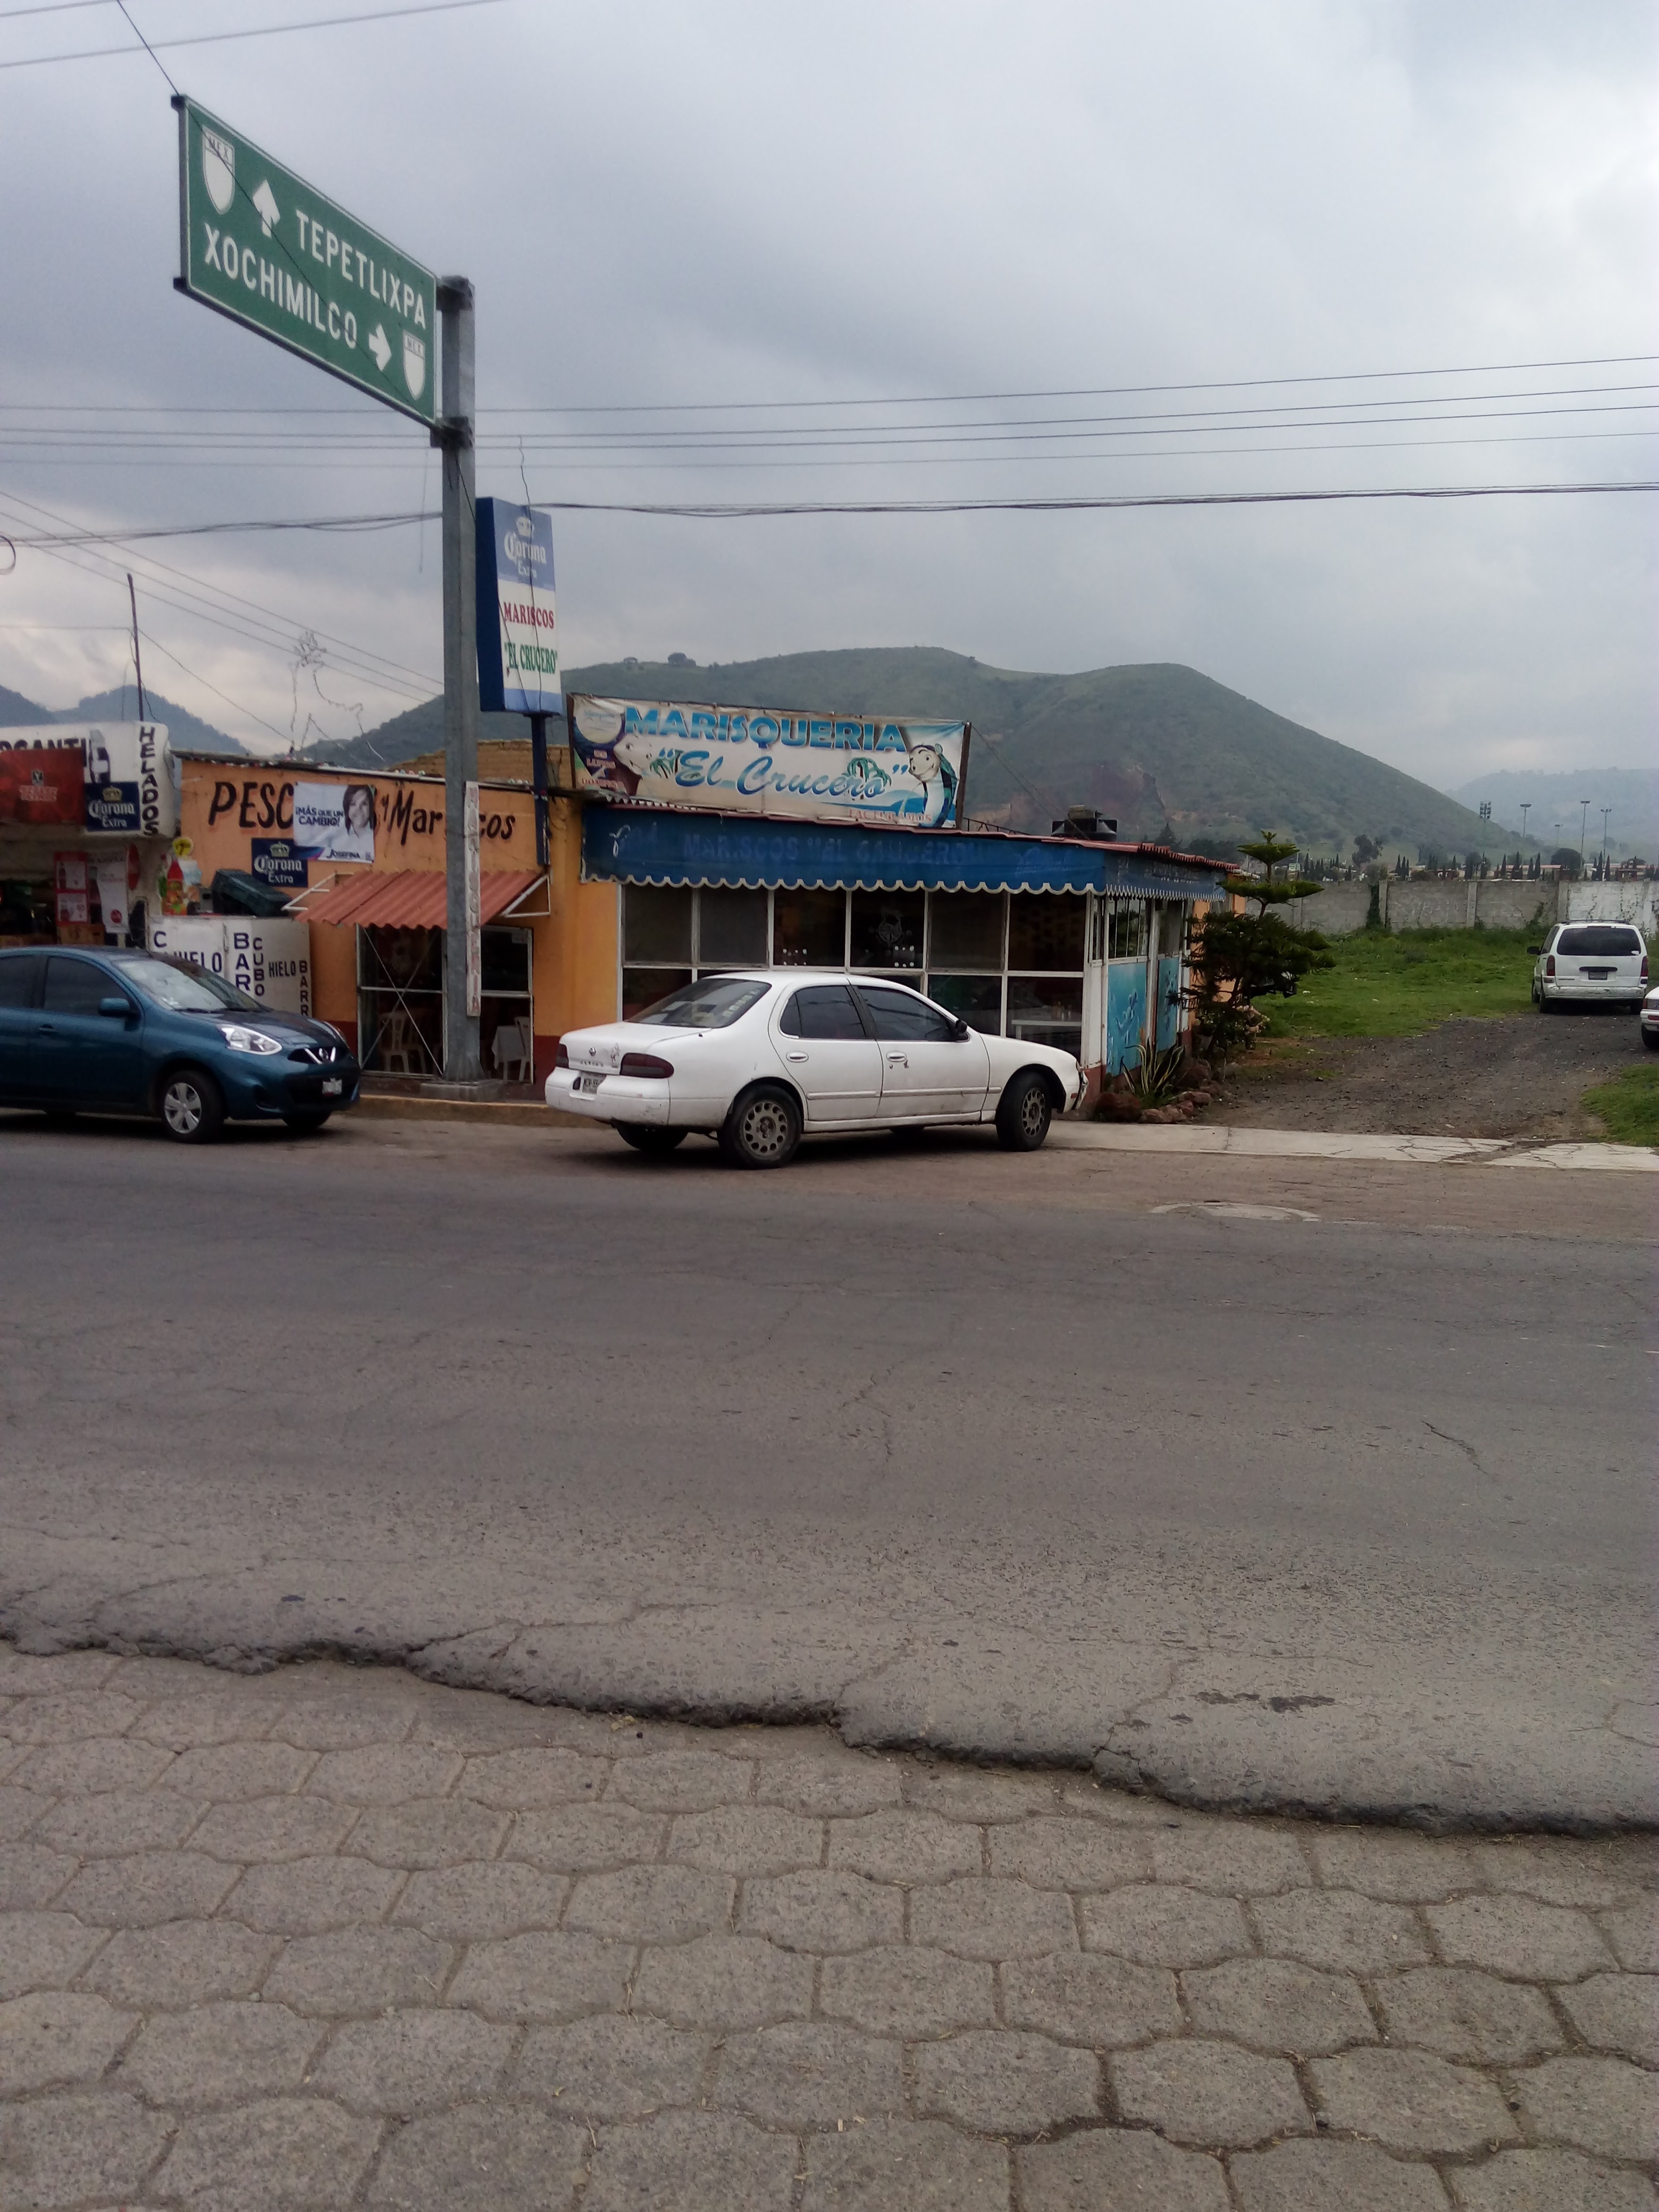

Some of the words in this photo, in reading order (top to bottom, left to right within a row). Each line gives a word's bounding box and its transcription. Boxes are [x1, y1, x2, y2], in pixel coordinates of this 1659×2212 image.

[296, 210, 426, 329] TEPETLIXPA
[204, 222, 357, 349] XOCHIMILCO
[504, 532, 547, 565] Corona
[504, 601, 554, 630] MARISCOS
[624, 707, 909, 752] MARISQUERIA
[139, 726, 158, 836] HELADOS
[88, 799, 135, 820] Corona
[102, 818, 128, 827] Extra
[253, 855, 303, 874] Corona
[268, 872, 294, 884] Extra
[269, 960, 296, 978] HIELO
[298, 960, 308, 1017] BARR
